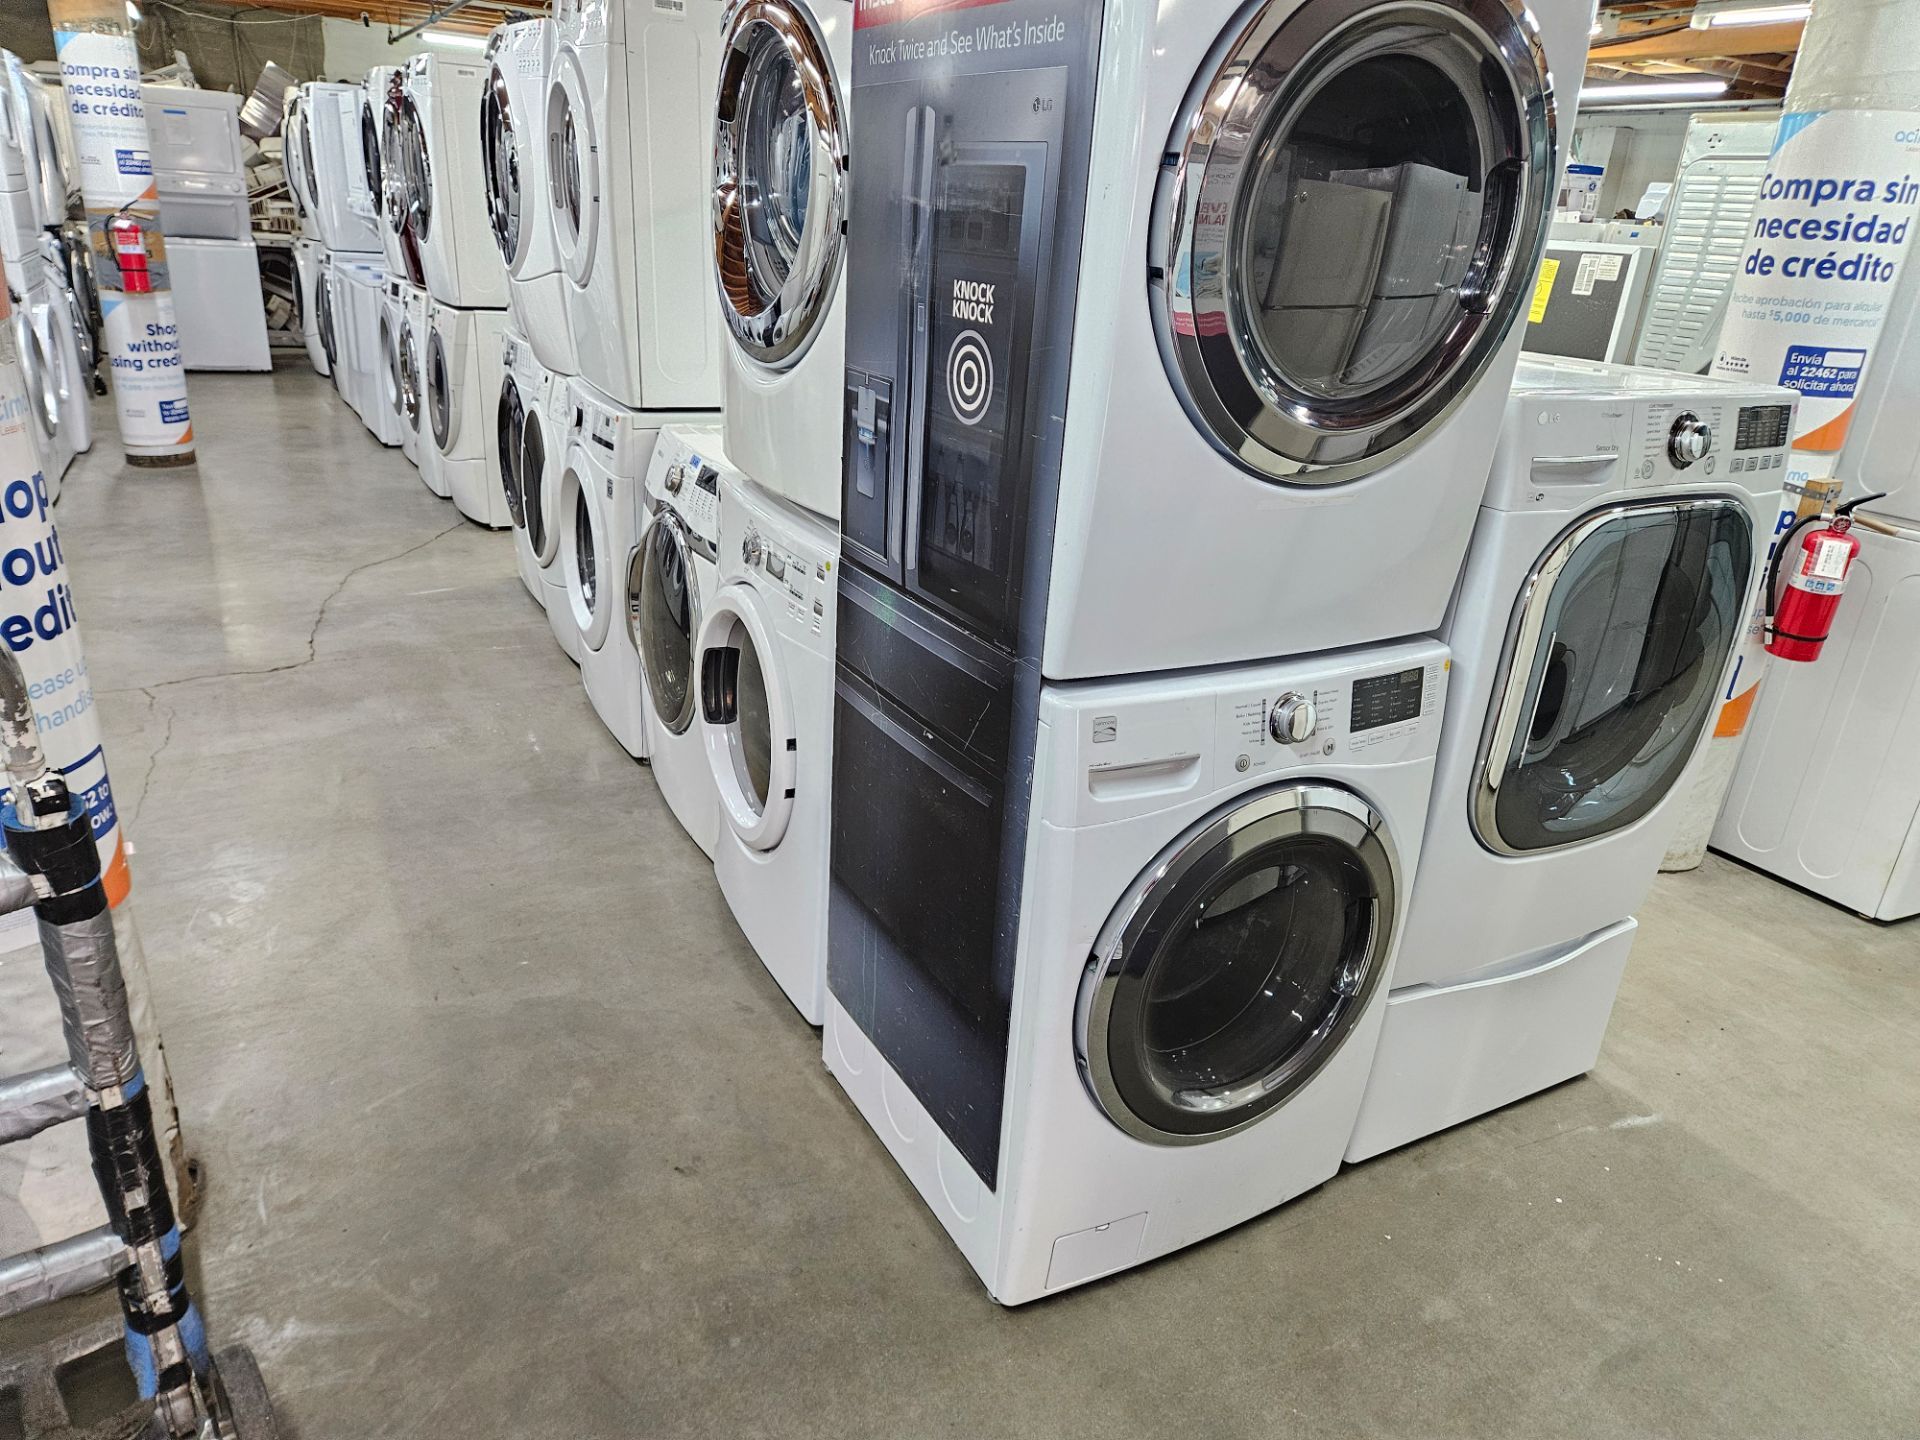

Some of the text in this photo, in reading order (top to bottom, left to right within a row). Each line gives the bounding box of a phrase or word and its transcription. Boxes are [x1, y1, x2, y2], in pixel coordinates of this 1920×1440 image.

[869, 14, 1065, 65] Knock Twice and See What's Inside
[72, 100, 89, 114] de
[1760, 173, 1919, 207] Compra sin
[1754, 213, 1910, 245] necesidad
[1745, 248, 1894, 283] de crédito
[953, 279, 996, 304] KNOCK
[952, 299, 994, 325] KNOCK
[1755, 294, 1821, 310] aprobación
[1824, 301, 1850, 313] para
[1742, 309, 1766, 320] hasta
[1769, 309, 1810, 324] $5,000
[1813, 314, 1830, 326] de
[1790, 351, 1823, 366] Envía
[1786, 366, 1858, 381] al 22462 para
[1783, 378, 1827, 391] solicitar
[98, 783, 109, 801] to
